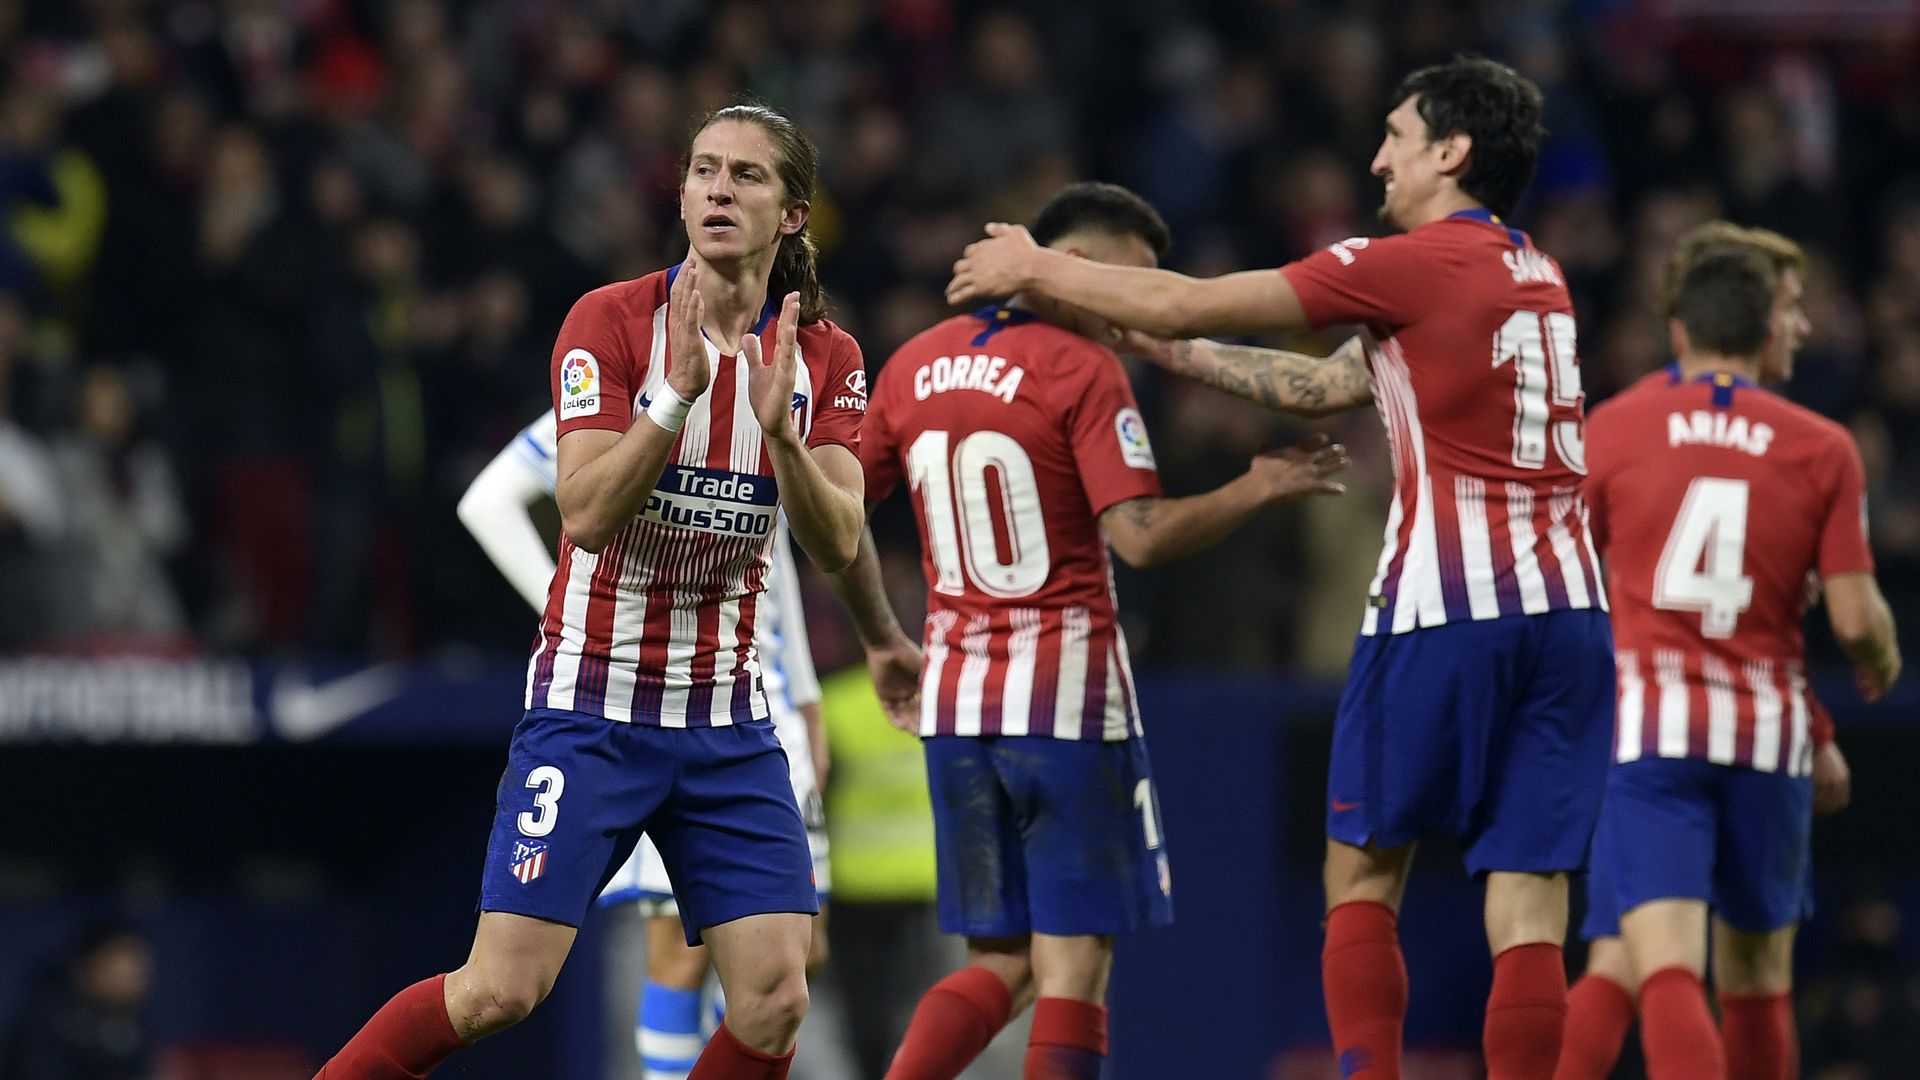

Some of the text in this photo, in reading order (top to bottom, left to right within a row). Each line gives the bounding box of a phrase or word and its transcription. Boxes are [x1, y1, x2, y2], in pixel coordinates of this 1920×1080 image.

[914, 354, 1025, 404] CORREA
[1667, 410, 1774, 457] ARIAS
[677, 468, 754, 501] Trade
[638, 495, 770, 536] Plus500
[906, 429, 1050, 598] 10
[1652, 475, 1754, 640] 4
[517, 765, 565, 837] 3
